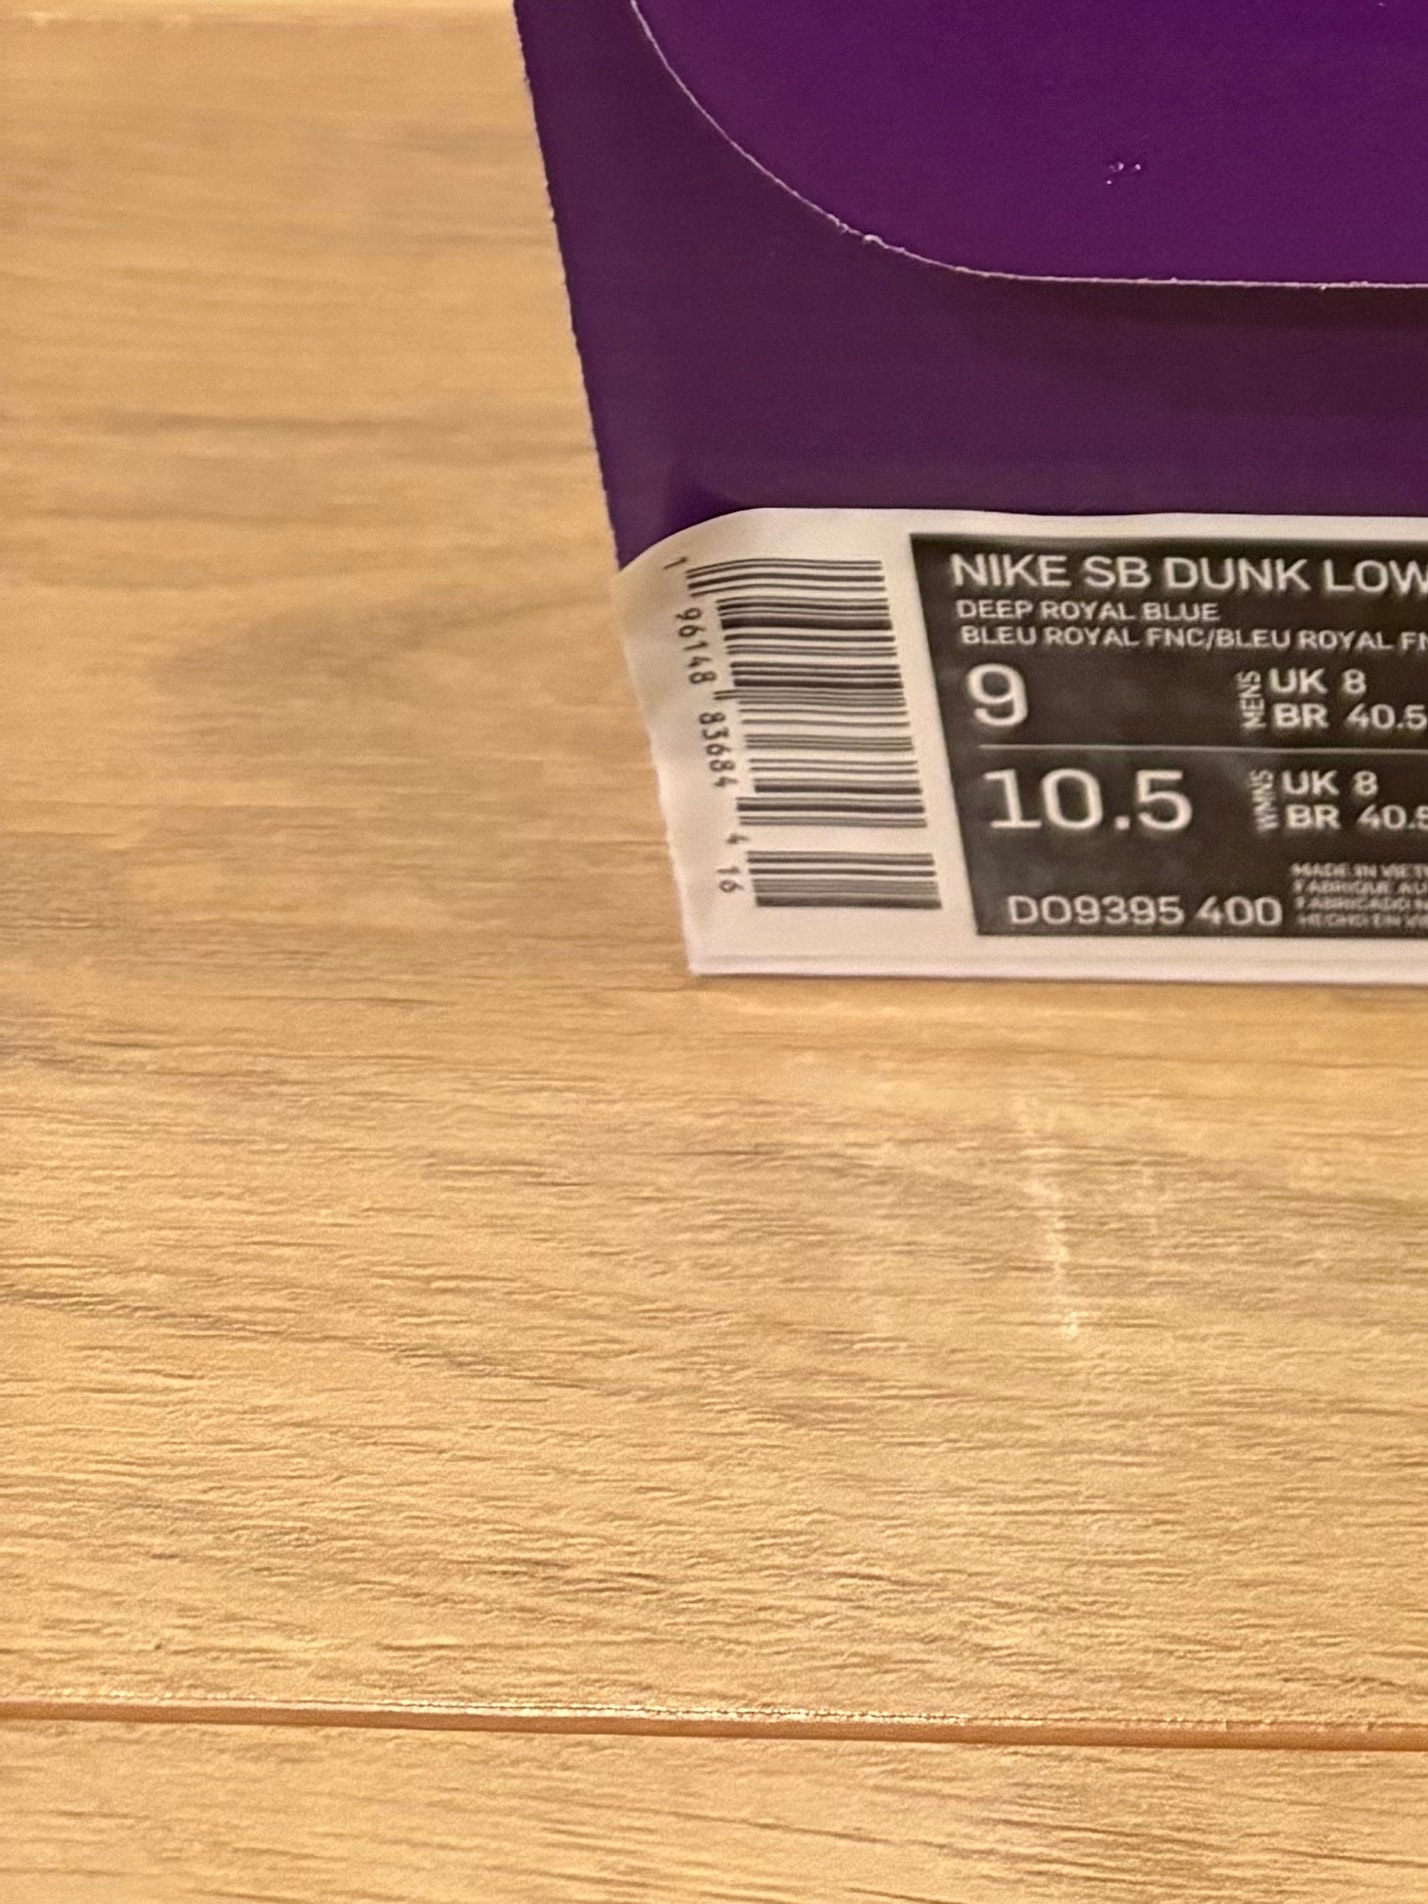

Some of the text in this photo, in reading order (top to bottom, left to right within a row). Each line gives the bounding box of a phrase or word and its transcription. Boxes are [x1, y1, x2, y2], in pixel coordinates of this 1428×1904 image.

[664, 557, 688, 570] 1
[950, 553, 1072, 588] NIKE
[1082, 555, 1151, 590] SB
[1163, 556, 1312, 591] DUNK
[954, 599, 1222, 622] DEEP ROYAL BLUE
[675, 607, 717, 685] 96148
[961, 626, 1038, 646] BLEU
[1044, 627, 1140, 647] ROYAL
[1146, 628, 1292, 651] FNC/BLEU
[1299, 630, 1394, 650] ROYAL
[966, 663, 1029, 727] 9
[1268, 667, 1367, 694] UK 8
[1237, 670, 1266, 729] MENS
[1273, 702, 1428, 731] BR 40.5
[698, 711, 739, 788] 83684
[1281, 770, 1379, 796] UK 8
[983, 767, 1193, 831] 10.5
[1286, 804, 1341, 830] BR
[717, 866, 744, 893] 16
[1195, 896, 1284, 927] 400
